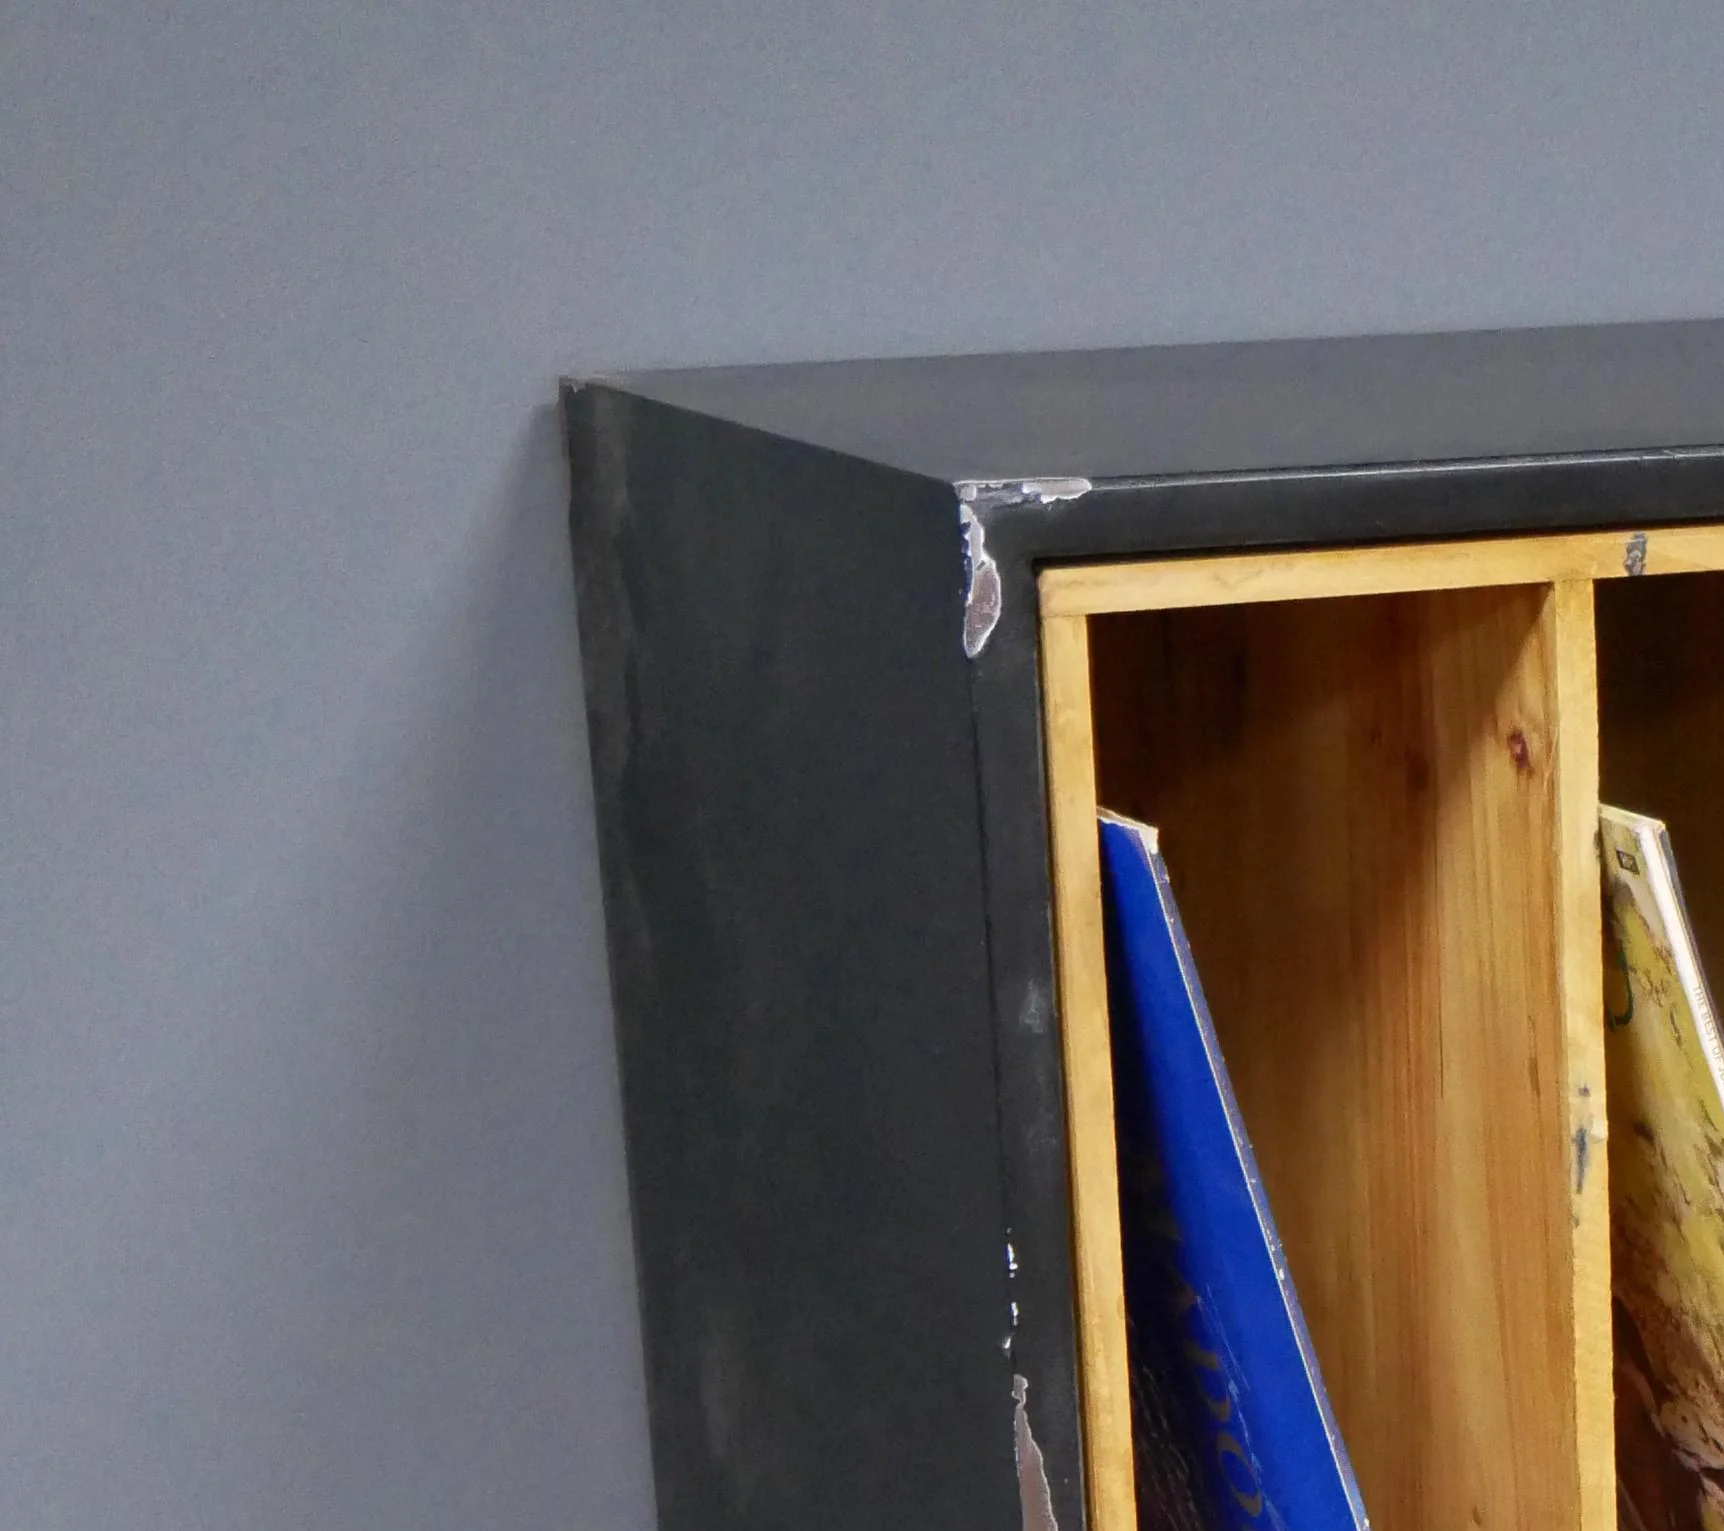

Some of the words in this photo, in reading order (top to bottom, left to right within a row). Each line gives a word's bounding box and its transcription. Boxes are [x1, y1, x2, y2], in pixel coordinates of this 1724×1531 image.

[1691, 984, 1706, 1008] THE
[1699, 1011, 1718, 1042] BEST
[1710, 1044, 1724, 1062] OF
